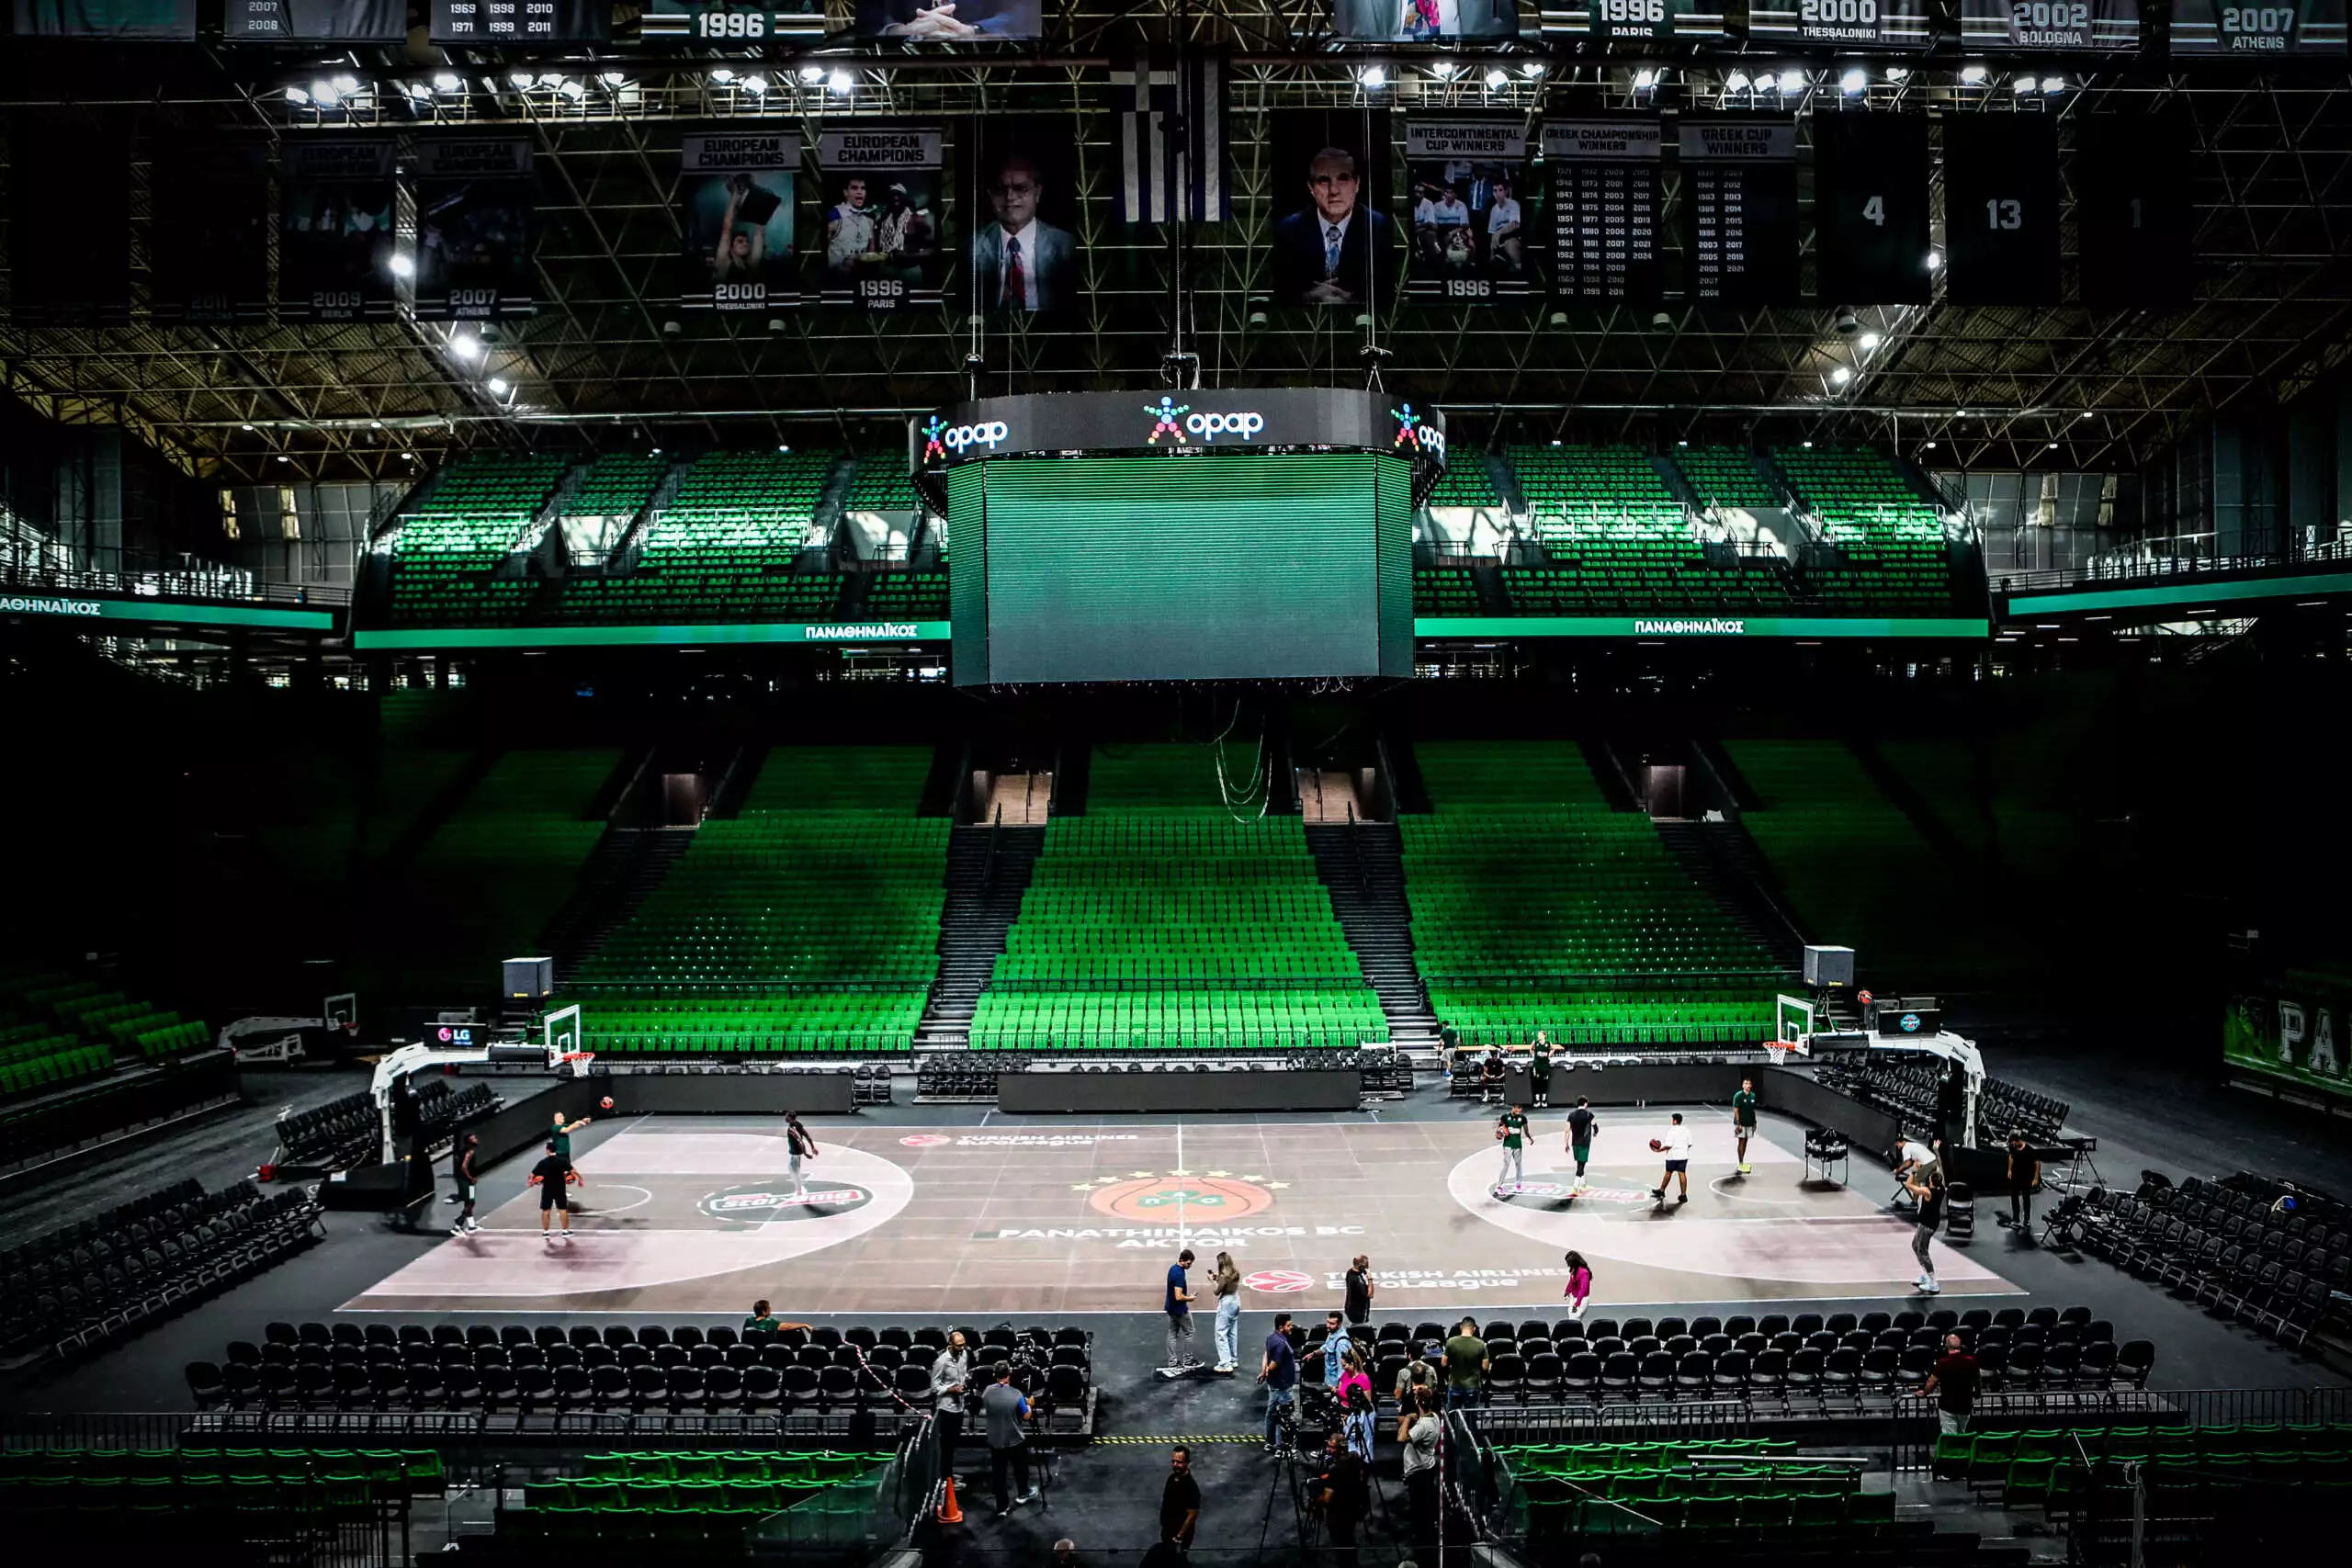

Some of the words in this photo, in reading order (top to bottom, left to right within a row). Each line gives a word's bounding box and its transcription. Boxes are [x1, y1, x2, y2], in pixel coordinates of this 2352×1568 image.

[248, 1, 278, 12] 2007
[450, 4, 476, 14] 1969
[490, 4, 515, 14] 1998
[526, 4, 553, 14] 2010
[1599, 0, 1664, 22] 1996
[1801, 0, 1876, 23] 2000
[2013, 3, 2087, 28] 2002
[2222, 7, 2294, 32] 2007
[451, 22, 474, 32] 1971
[489, 22, 514, 32] 1999
[527, 22, 551, 32] 2011
[698, 13, 764, 38] 1996
[1611, 27, 1654, 37] PARIS
[1802, 27, 1876, 39] THESSALONIKI
[2019, 30, 2083, 44] BOLOGNA
[2232, 36, 2284, 49] ATHENS
[1410, 128, 1520, 140] INTERCONTINENTAL
[1545, 129, 1578, 140] GREEK
[1580, 129, 1659, 141] CHAMPIONSHIP
[1702, 129, 1744, 141] GREEK
[1747, 129, 1772, 141] CUP
[704, 139, 780, 152] EUROPEAN
[843, 135, 920, 149] EUROPEAN
[1425, 140, 1449, 151] CUP
[1451, 140, 1506, 152] WINNERS
[1578, 140, 1626, 151] WINNERS
[1706, 142, 1769, 154] WINNERS
[698, 152, 785, 165] CHAMPIONS
[838, 149, 924, 163] CHAMPIONS
[1862, 195, 1885, 226] 4
[1985, 198, 2021, 230] 13
[2129, 197, 2142, 229] 1
[715, 283, 766, 299] 2000
[860, 279, 903, 297] 1996
[1446, 279, 1491, 297] 1996
[312, 290, 362, 307] 2009
[448, 288, 498, 306] 2007
[867, 299, 897, 309] PARIS
[455, 306, 492, 317] ATHENS
[1186, 412, 1264, 441] opap
[944, 421, 1009, 454] opap
[806, 623, 918, 638] ΠΑΝΑΘΗΝΑΪΚΟΣ
[1634, 618, 1744, 634] ΠΑΝΑΘΗΝΑΪΚΟΣ
[453, 1028, 471, 1041] LG
[999, 1226, 1306, 1238] PANATHINAIKOS
[1316, 1225, 1366, 1235] BC
[1115, 1237, 1249, 1248] AKTOR
